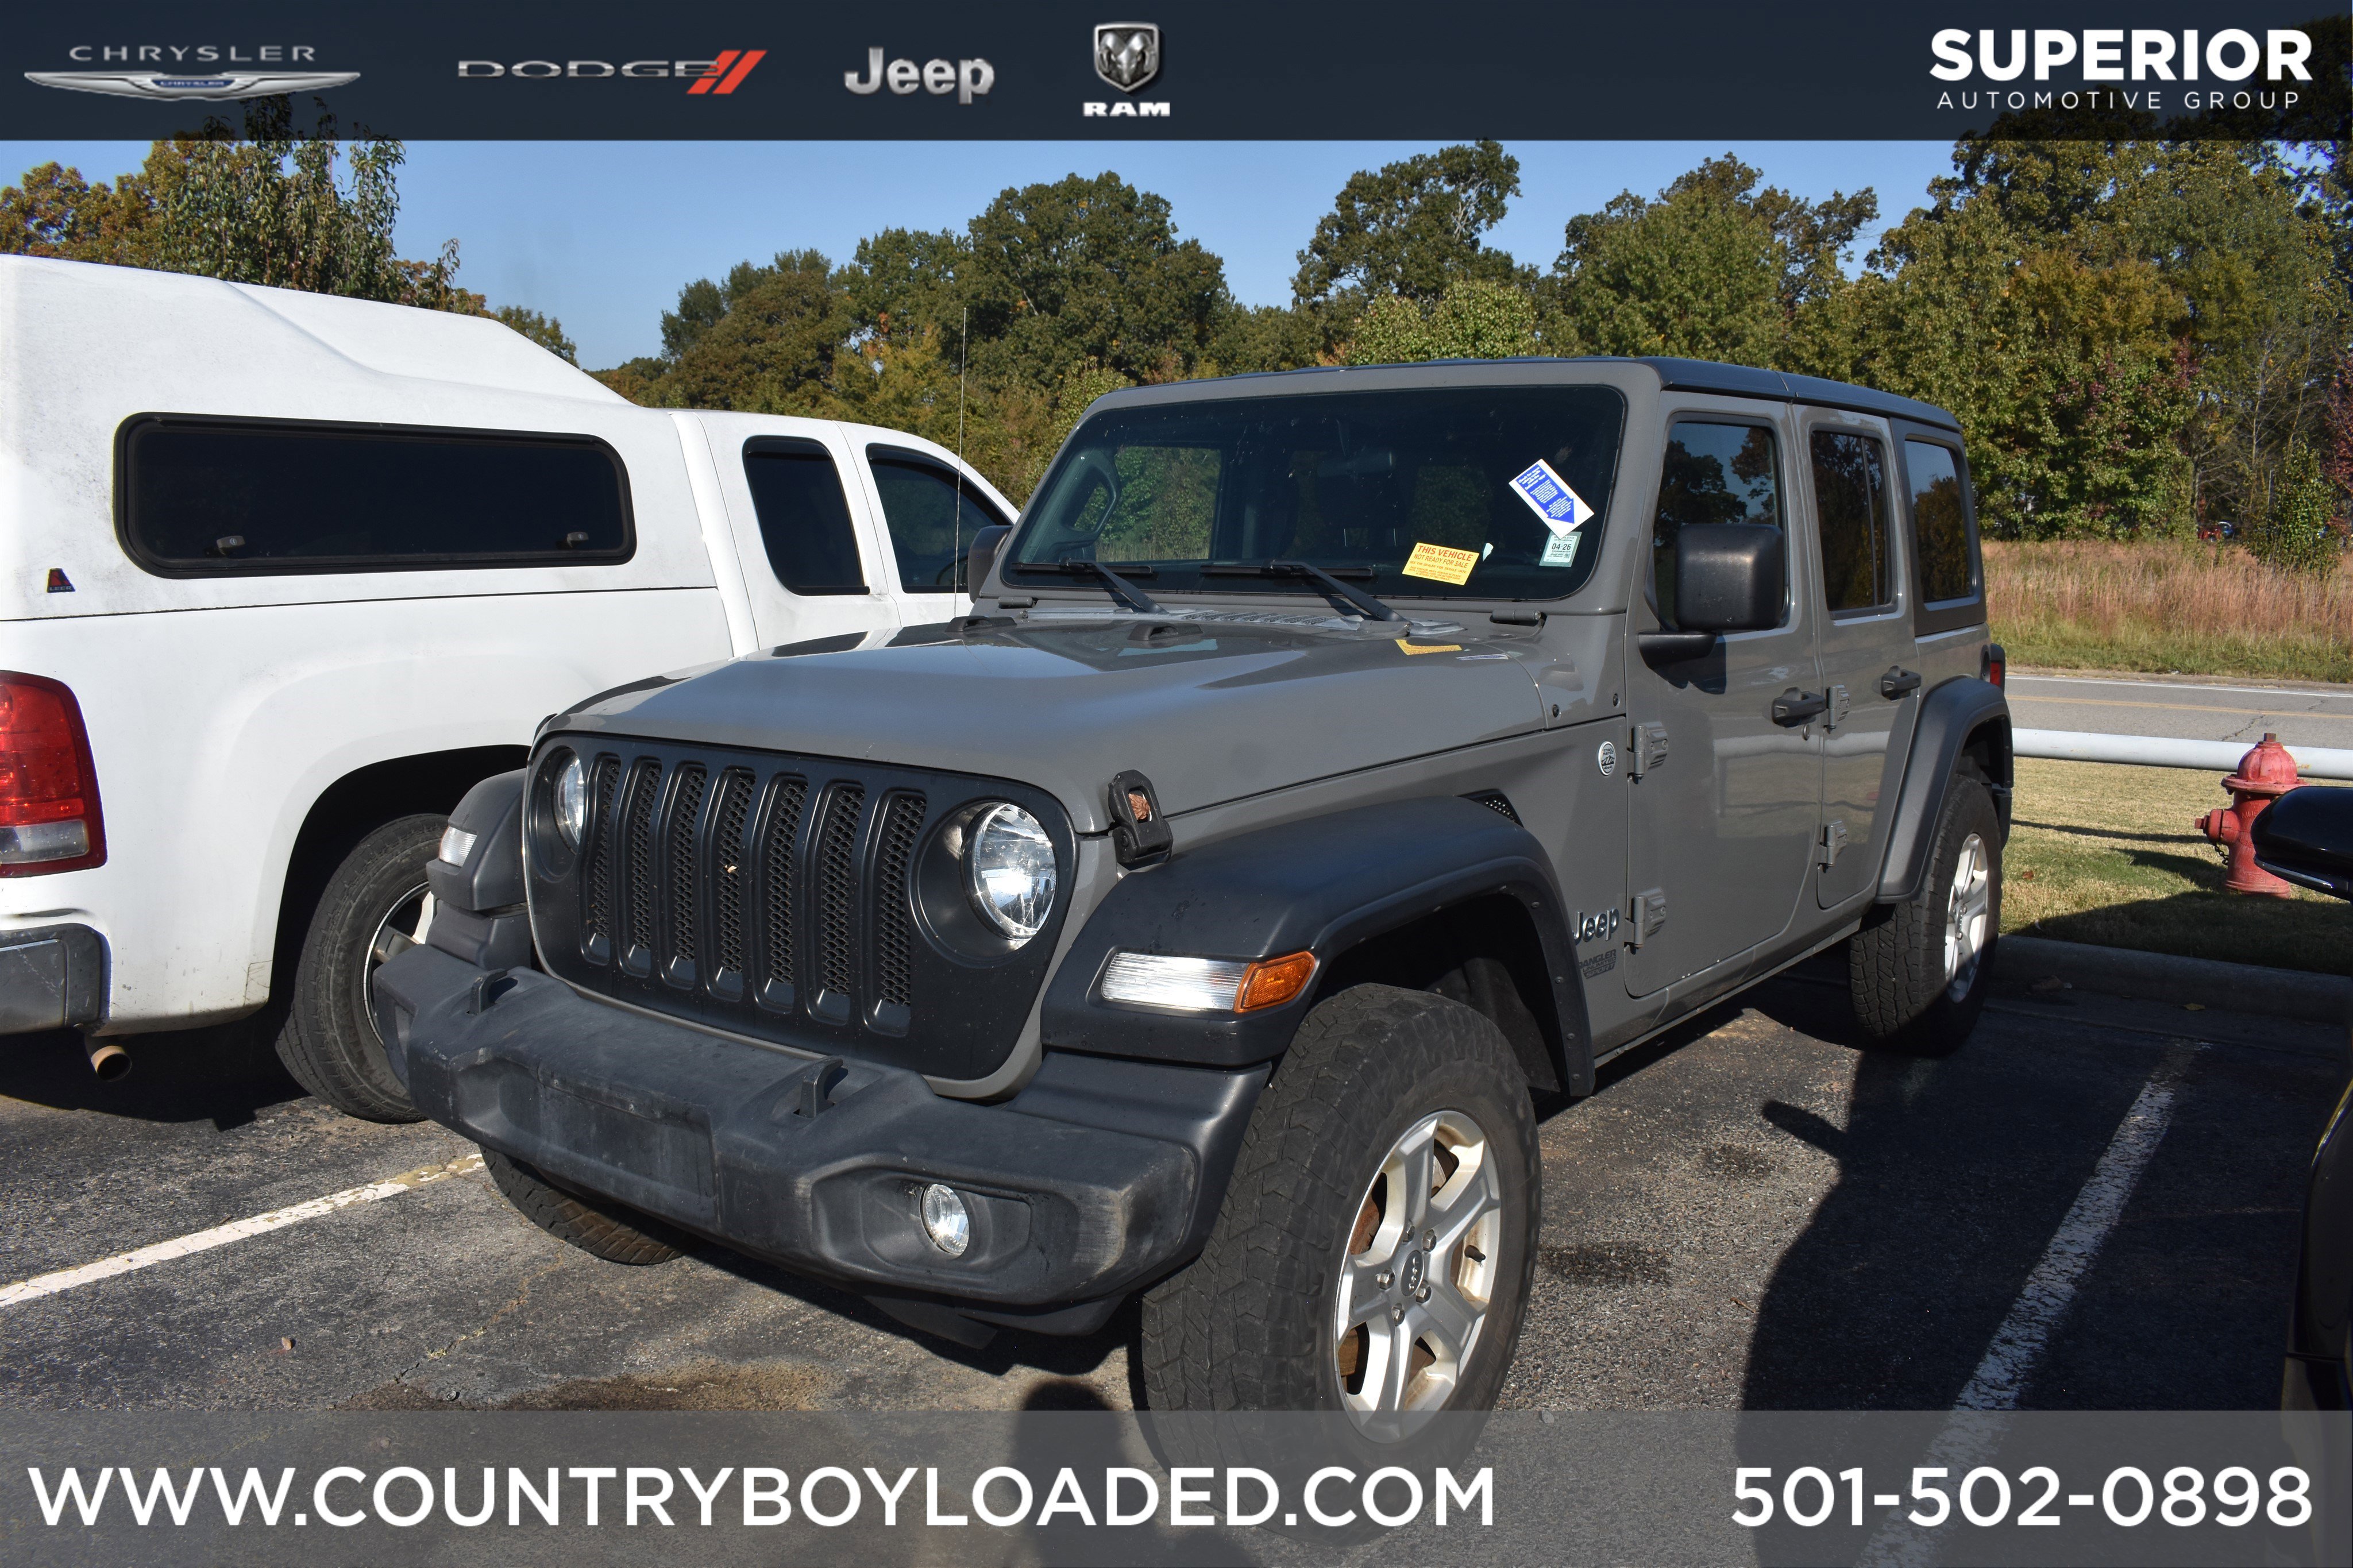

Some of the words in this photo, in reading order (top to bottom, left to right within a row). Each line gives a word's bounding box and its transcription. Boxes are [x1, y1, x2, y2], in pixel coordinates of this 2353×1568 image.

[1417, 545, 1436, 555] THIS
[1438, 549, 1473, 561] VEHICLE
[1425, 555, 1443, 563] READY
[1573, 909, 1619, 945] Jeep
[1579, 949, 1616, 968] RANGLER
